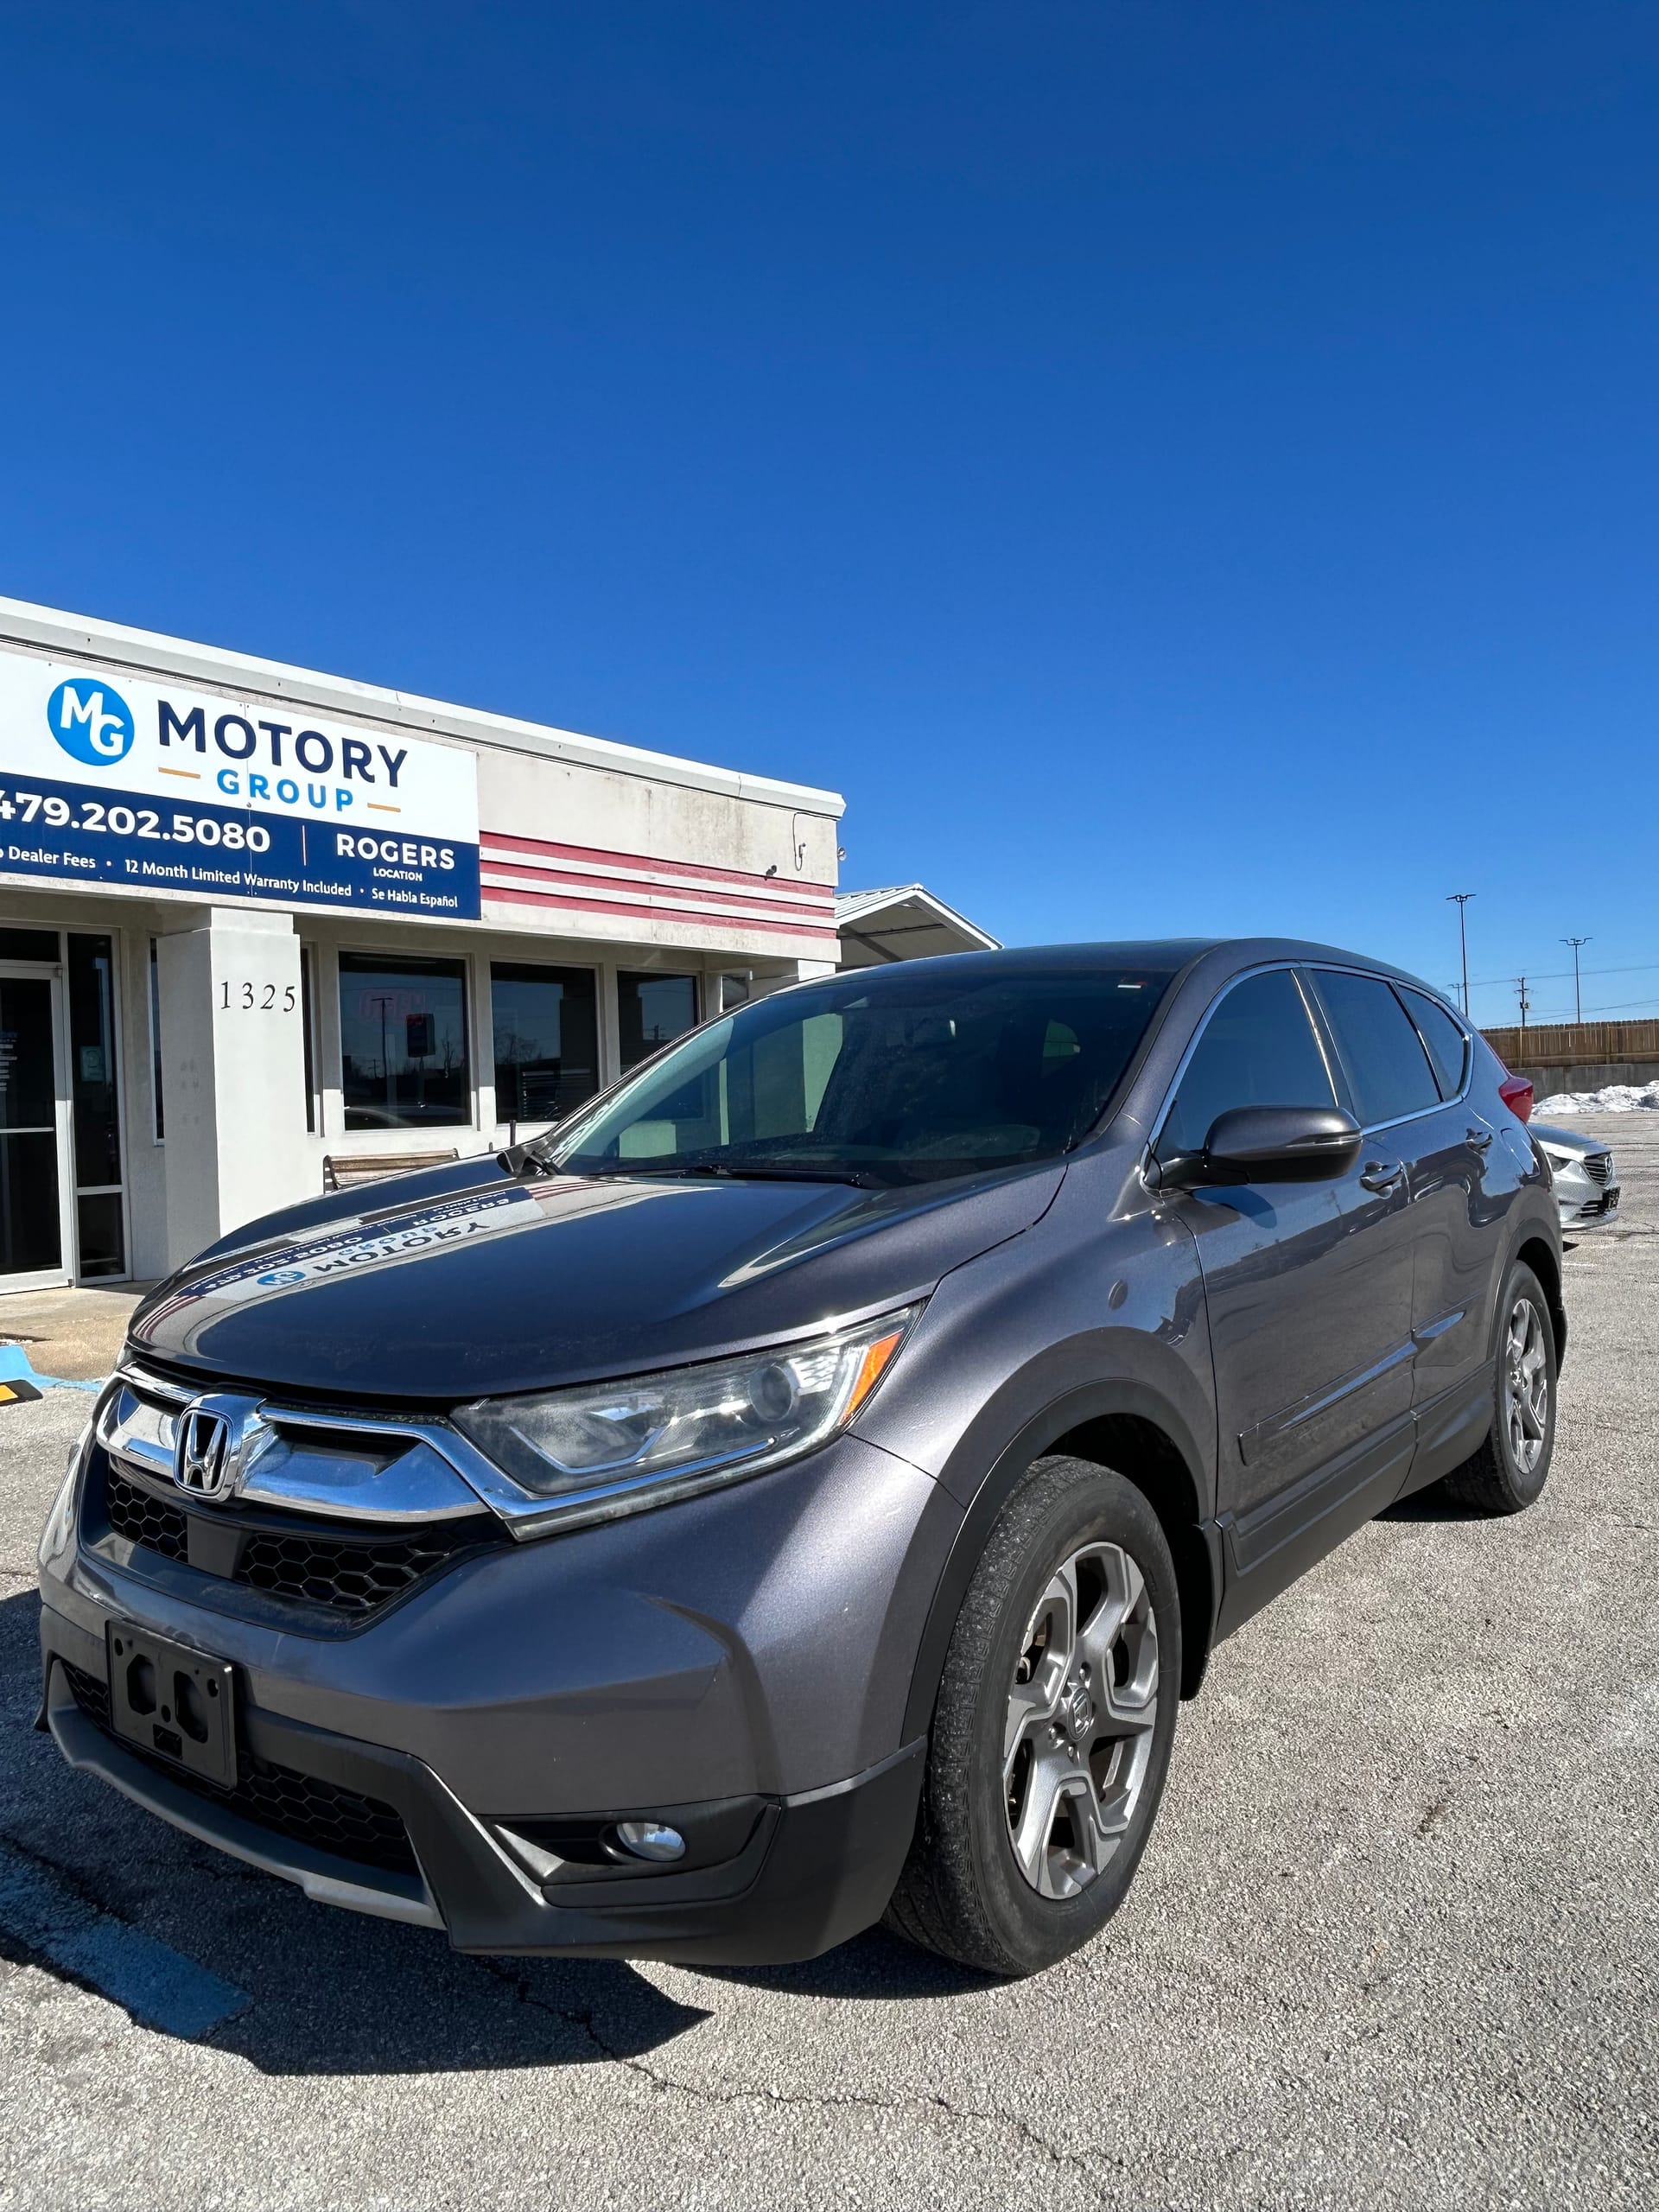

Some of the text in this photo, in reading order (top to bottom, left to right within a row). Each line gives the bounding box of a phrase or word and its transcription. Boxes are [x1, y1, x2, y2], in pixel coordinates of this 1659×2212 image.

[60, 686, 124, 756] MG
[158, 700, 408, 787] MOTORY
[217, 769, 353, 811] GROUP
[0, 790, 270, 853] 479.202.5080
[9, 846, 60, 864] Dealer
[63, 852, 96, 868] Fees
[336, 833, 455, 870] ROGERS
[124, 859, 352, 896] 12 Month Limited Warranty Included
[373, 867, 423, 881] LOCATION
[372, 887, 458, 908] Se Habla Español
[221, 981, 296, 1013] 1325
